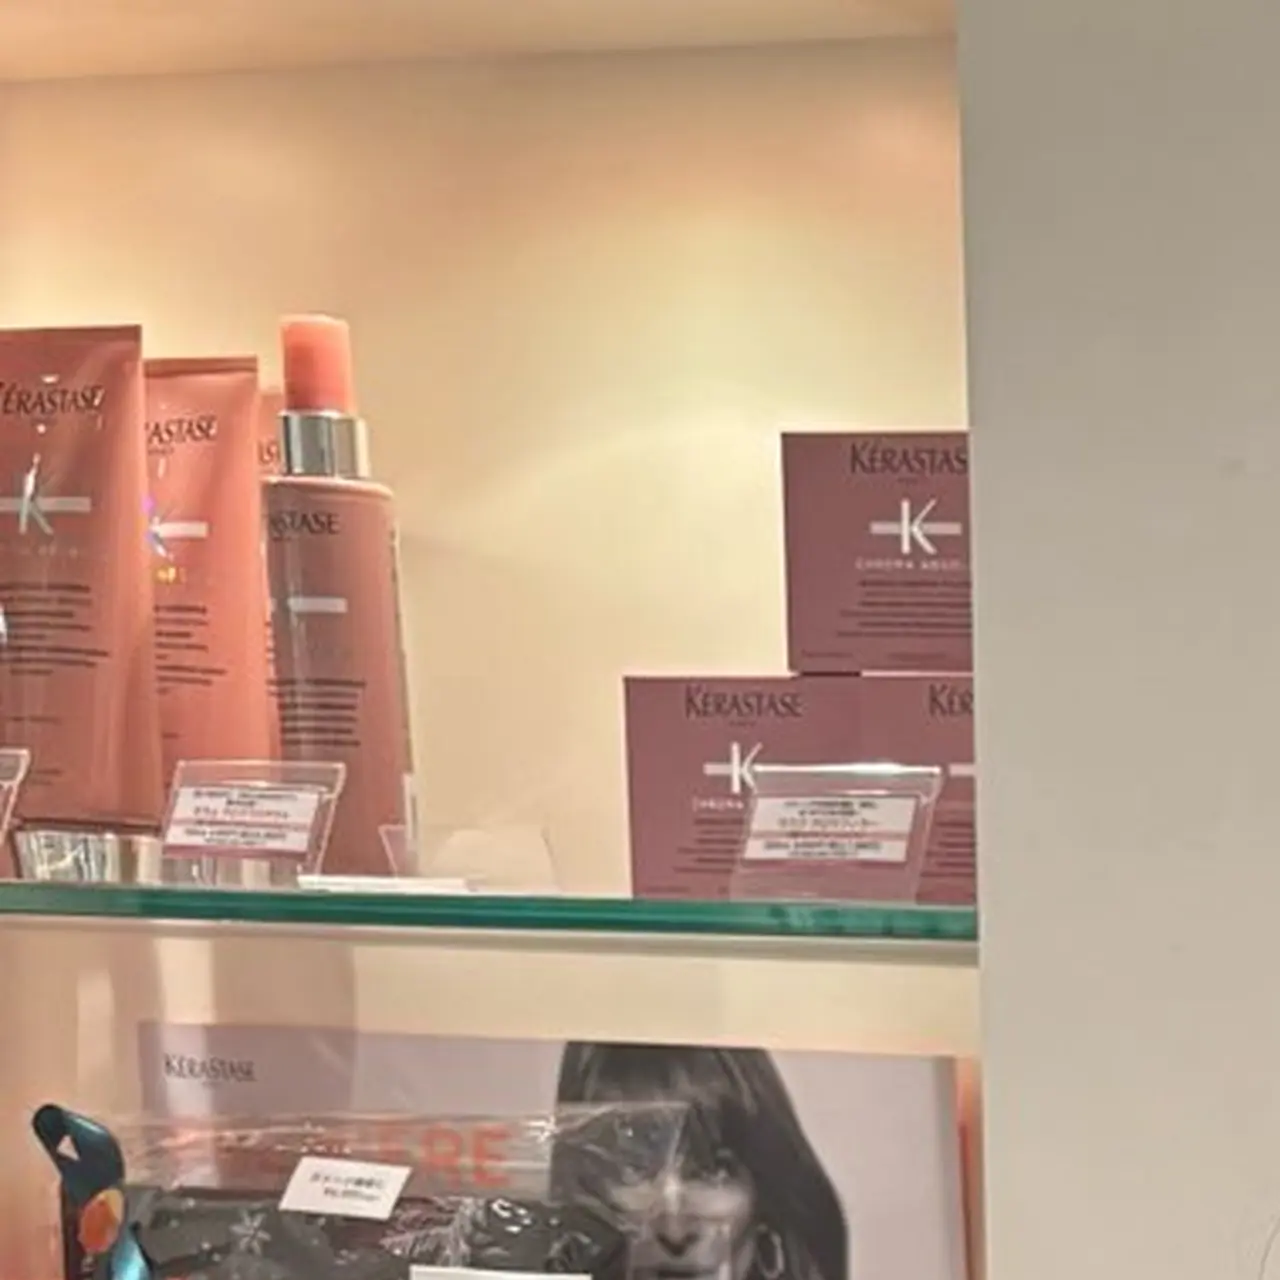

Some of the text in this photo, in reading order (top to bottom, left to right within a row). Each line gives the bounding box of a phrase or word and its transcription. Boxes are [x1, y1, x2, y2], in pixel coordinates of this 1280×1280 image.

[0, 381, 104, 415] ÉRASTASE
[146, 415, 217, 445] ASTASE
[851, 440, 968, 475] KÉRASTAS
[901, 498, 937, 555] K
[685, 684, 803, 719] KÉRASTASE
[731, 742, 763, 794] K
[163, 1051, 258, 1084] KÉRASTASE
